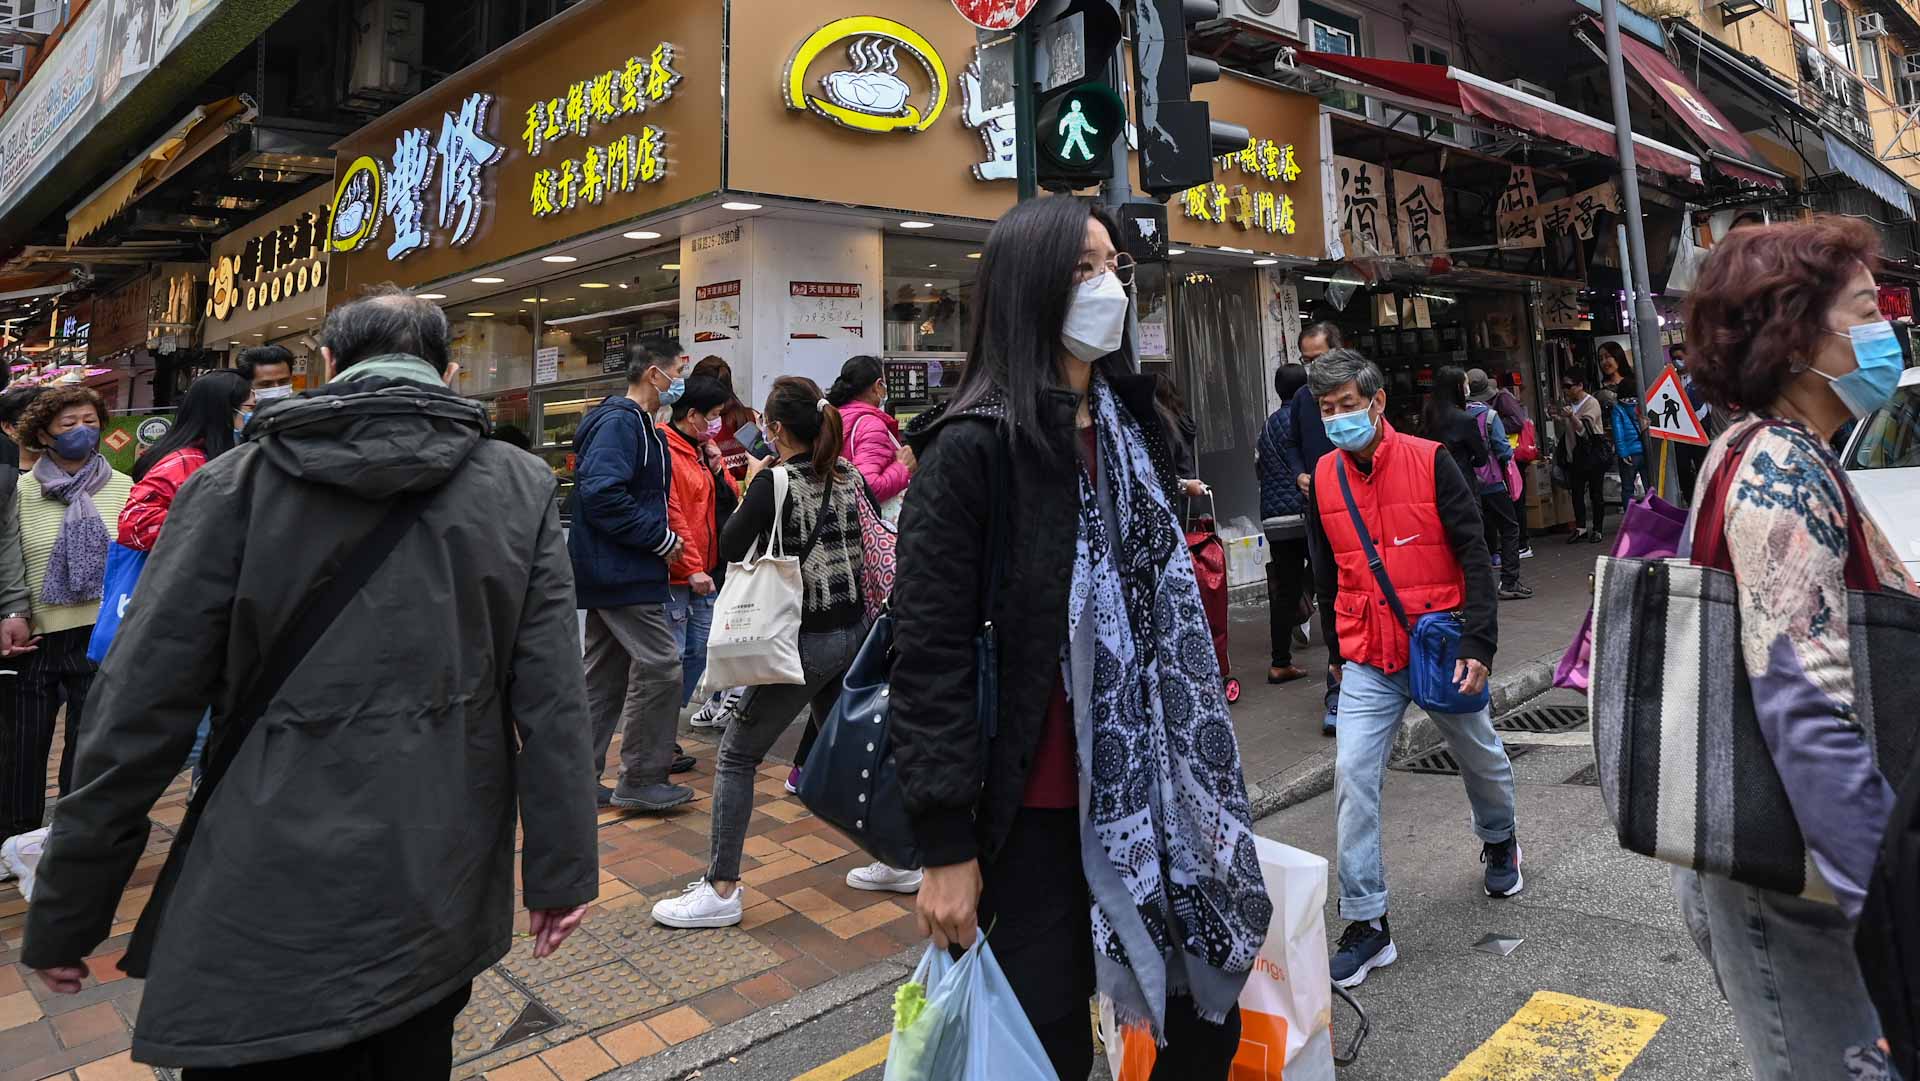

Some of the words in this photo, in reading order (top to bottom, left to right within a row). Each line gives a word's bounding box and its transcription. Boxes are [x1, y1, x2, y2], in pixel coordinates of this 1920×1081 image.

[522, 42, 678, 155] 手工鮮蝦雲吞
[530, 126, 662, 217] 餃子專門店
[1224, 137, 1302, 181] 蝦雲吞
